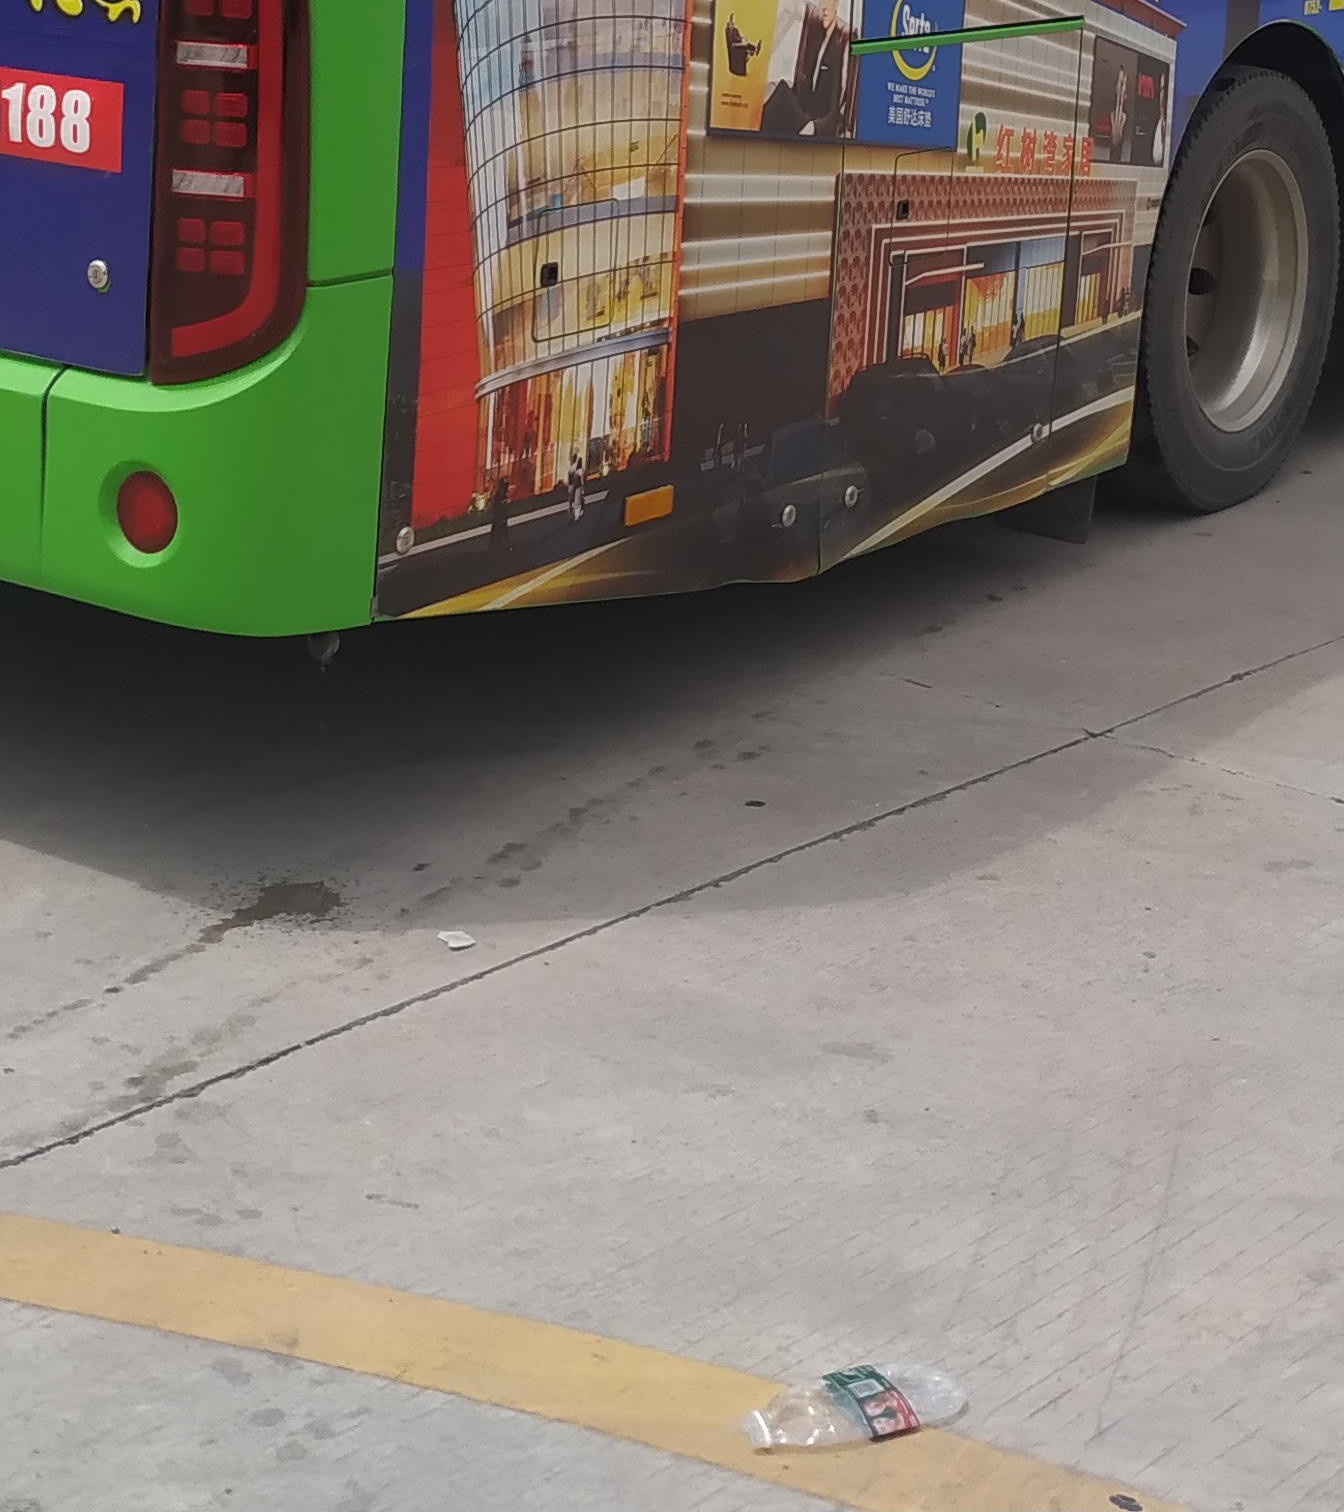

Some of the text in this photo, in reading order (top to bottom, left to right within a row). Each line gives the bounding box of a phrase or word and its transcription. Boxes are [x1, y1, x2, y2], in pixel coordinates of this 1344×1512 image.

[996, 124, 1094, 177] 红树湾家居
